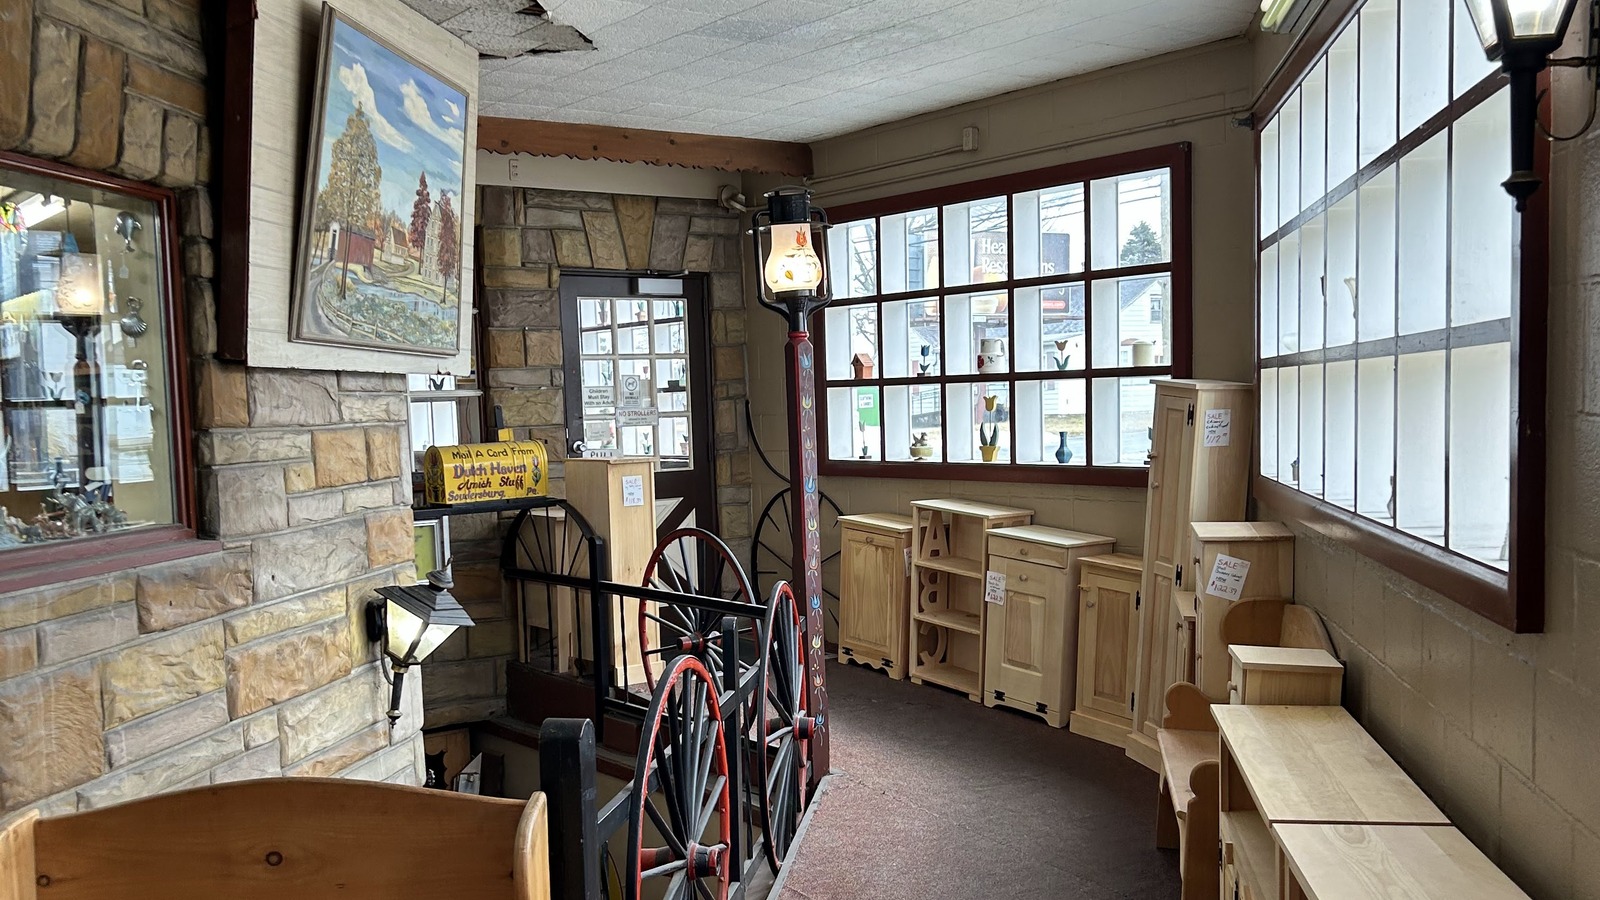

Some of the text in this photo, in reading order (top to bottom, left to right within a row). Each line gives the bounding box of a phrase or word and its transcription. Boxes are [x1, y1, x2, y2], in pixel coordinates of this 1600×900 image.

[452, 450, 472, 460] Mail
[487, 448, 509, 458] Card
[512, 447, 535, 456] From
[453, 461, 527, 479] Dutch Haven
[457, 475, 524, 491] Amish Stuff
[1217, 558, 1239, 570] SALE
